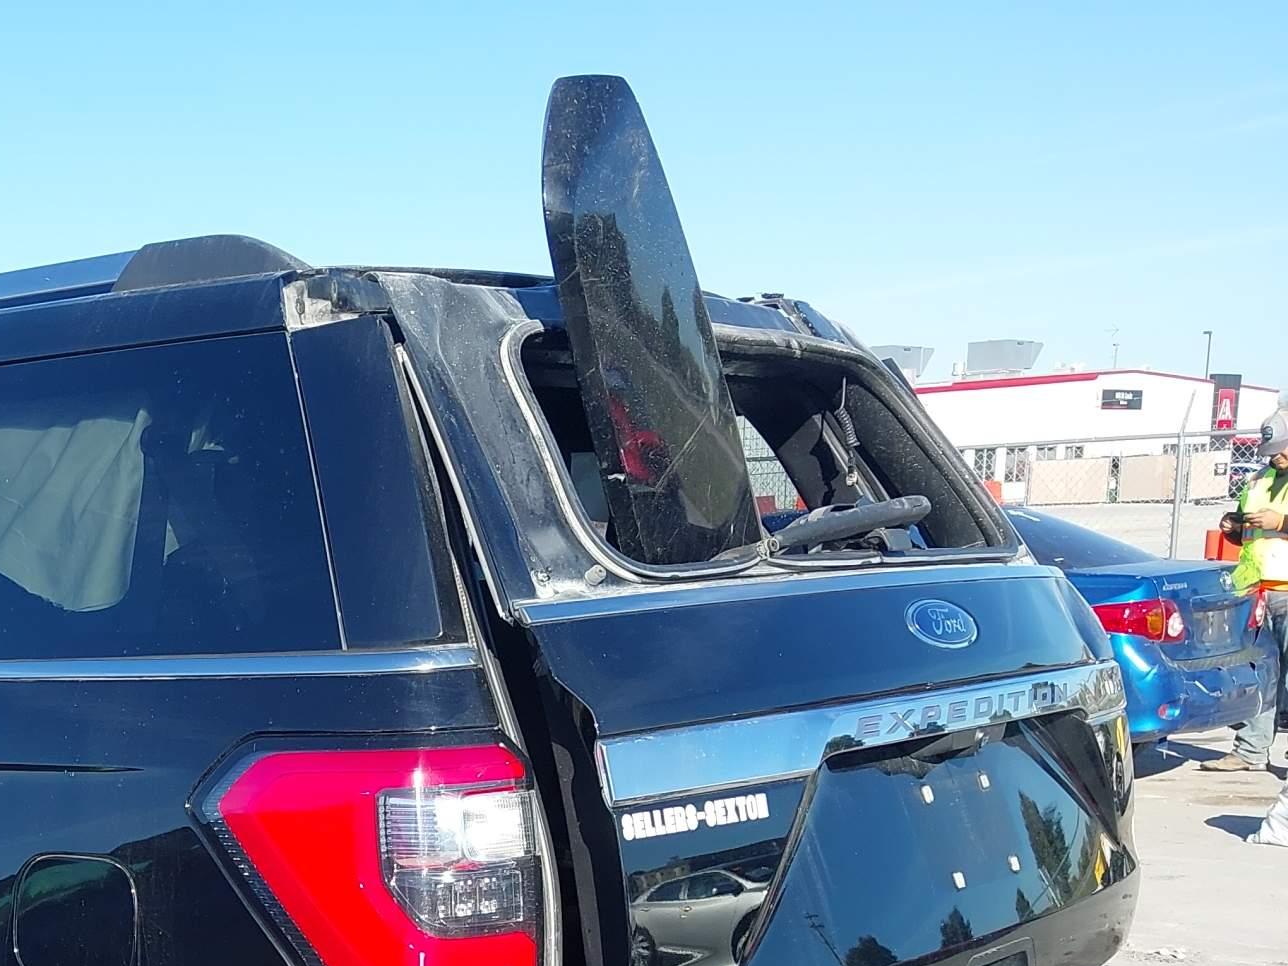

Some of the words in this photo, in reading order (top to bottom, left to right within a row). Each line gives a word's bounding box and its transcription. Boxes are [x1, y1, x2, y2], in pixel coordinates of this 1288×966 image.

[927, 608, 967, 636] Ford
[855, 681, 1068, 740] EXPEDITION
[621, 792, 770, 841] SELLERS-SEXTON
